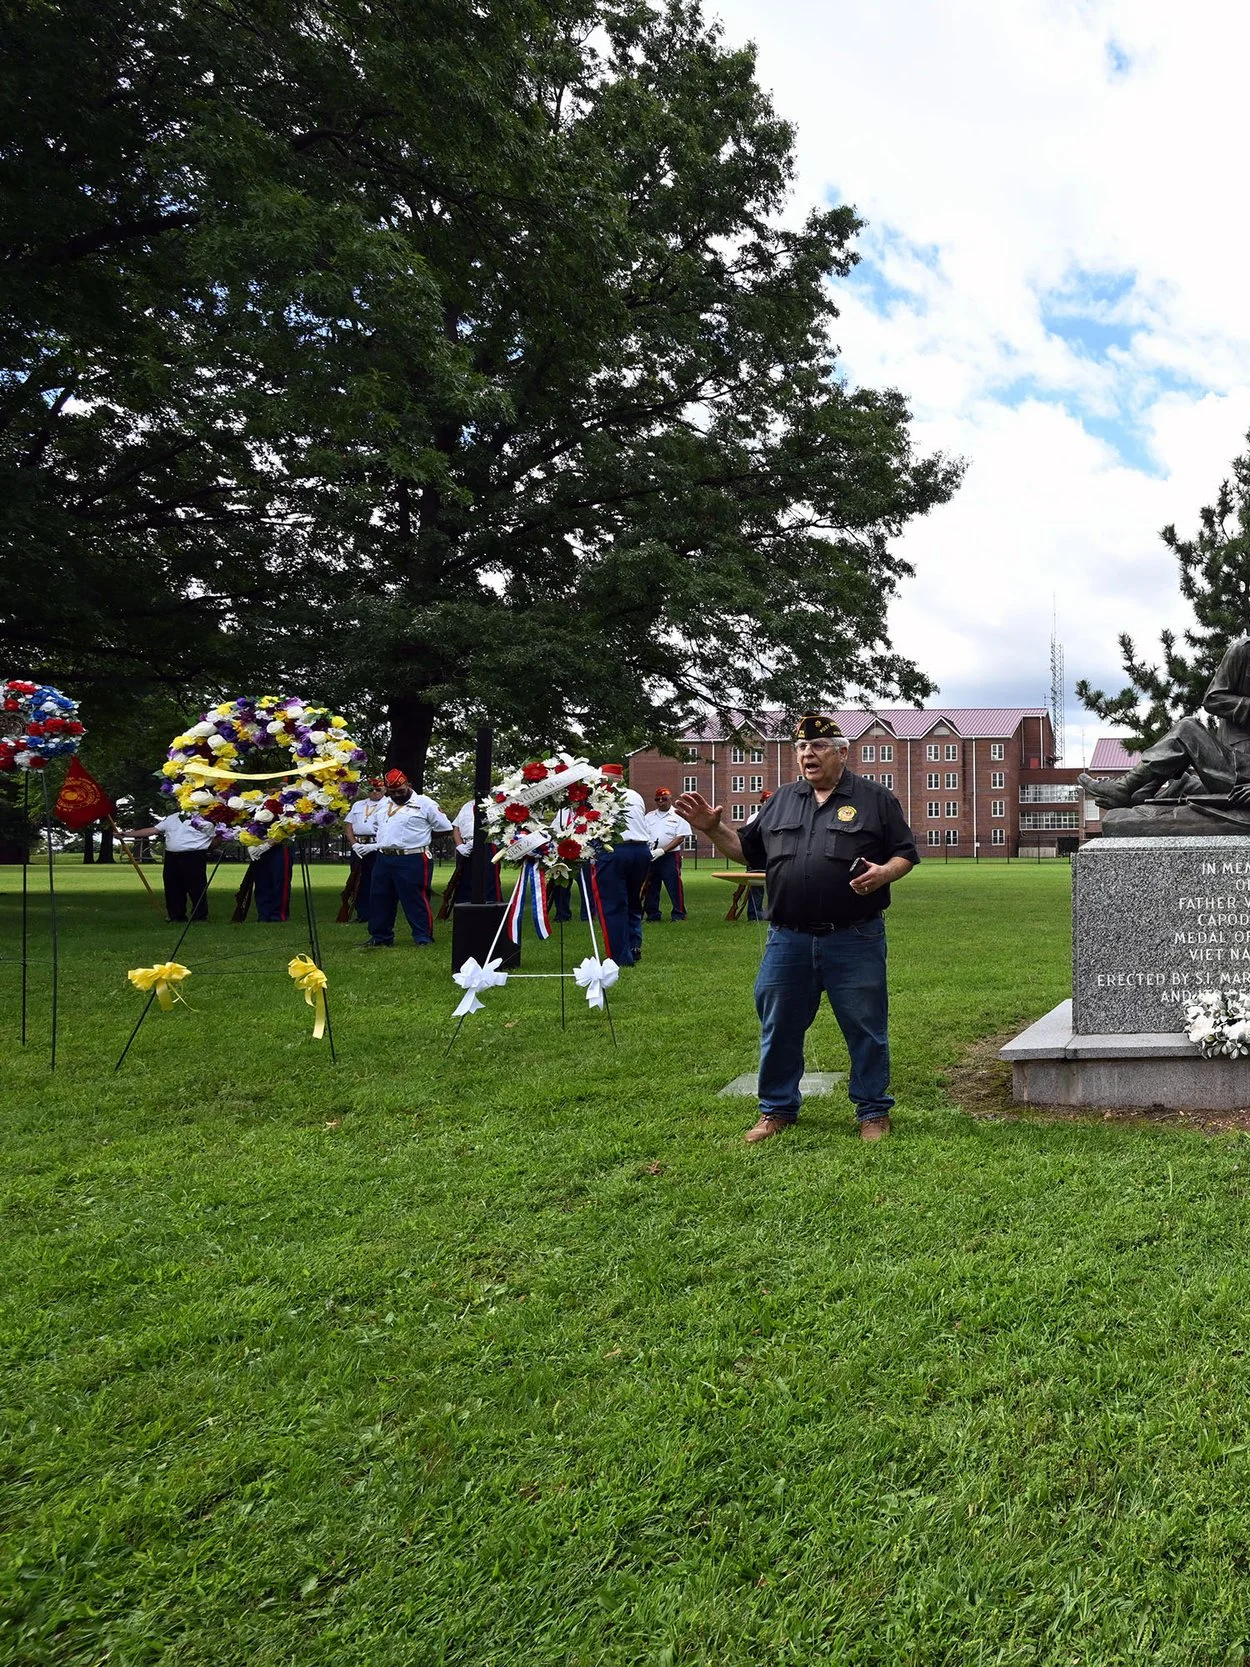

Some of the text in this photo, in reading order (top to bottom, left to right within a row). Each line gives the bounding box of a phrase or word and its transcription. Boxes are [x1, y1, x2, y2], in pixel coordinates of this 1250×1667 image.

[1202, 862, 1216, 874] IN
[1179, 896, 1237, 910] FATHER
[1174, 931, 1227, 944] MEDAL
[1189, 948, 1223, 961] VIET
[1097, 974, 1166, 987] ERECTED
[1172, 972, 1190, 985] BY
[1195, 971, 1213, 985] S.I.
[1160, 989, 1192, 1003] AND
